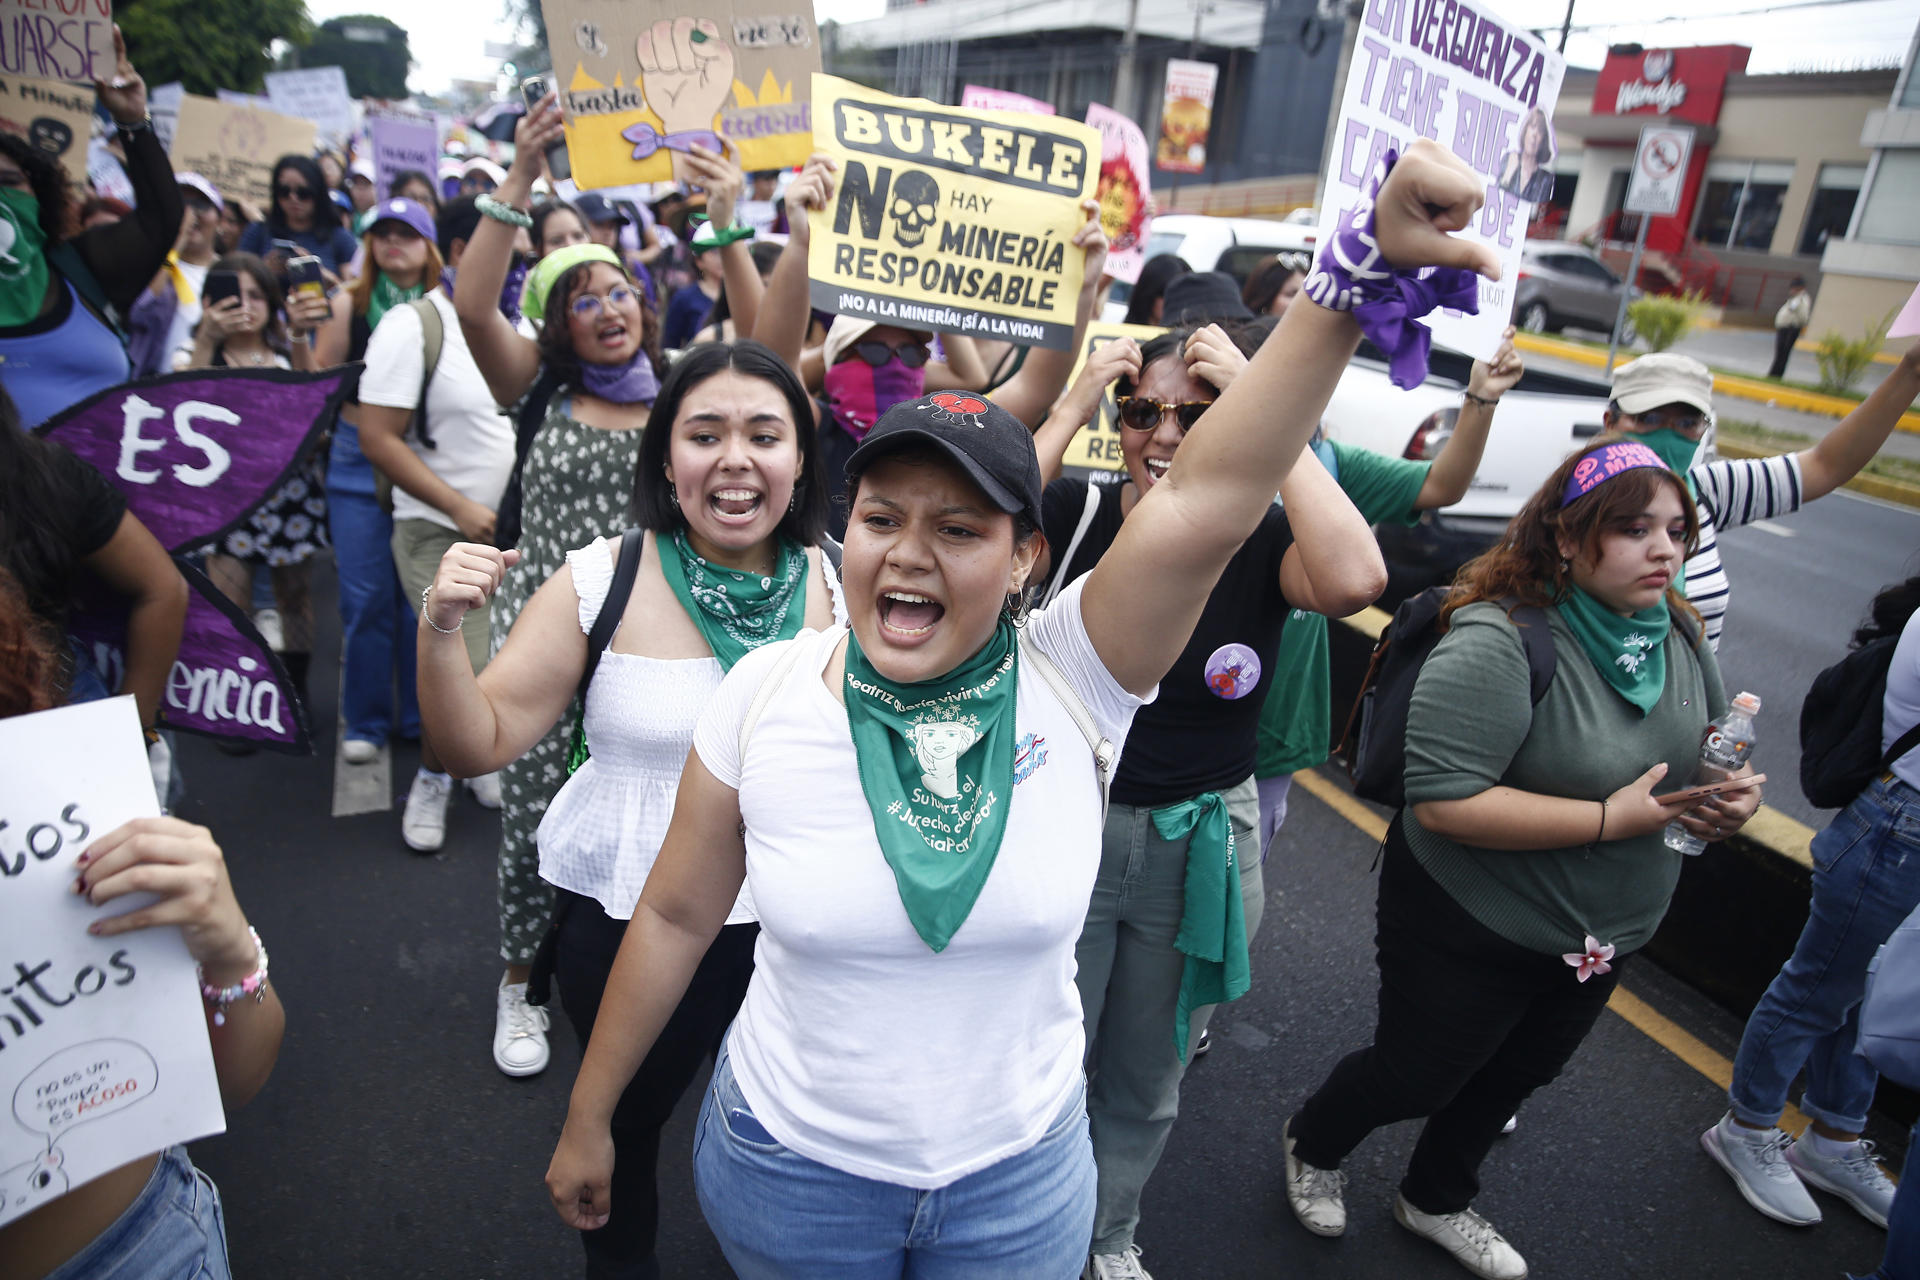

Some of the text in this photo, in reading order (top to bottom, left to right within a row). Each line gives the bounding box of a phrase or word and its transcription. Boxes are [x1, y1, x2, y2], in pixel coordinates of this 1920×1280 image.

[1361, 37, 1520, 180] TIENE QUE
[840, 104, 1084, 191] BUKELE
[950, 191, 993, 215] HAY
[1480, 184, 1520, 248] DE
[937, 220, 1065, 275] MINERÍA
[834, 243, 1059, 311] RESPONSABLE
[839, 294, 1045, 340] ¡NO A LA MINERÍA! ¡SÍ A LA VIDA!
[116, 393, 241, 488] ES
[938, 687, 973, 704] vivir
[980, 674, 1001, 692] ser
[912, 788, 930, 805] Su
[962, 774, 976, 793] el
[36, 1059, 110, 1098] no es un
[50, 1078, 137, 1125] es ACOSO
